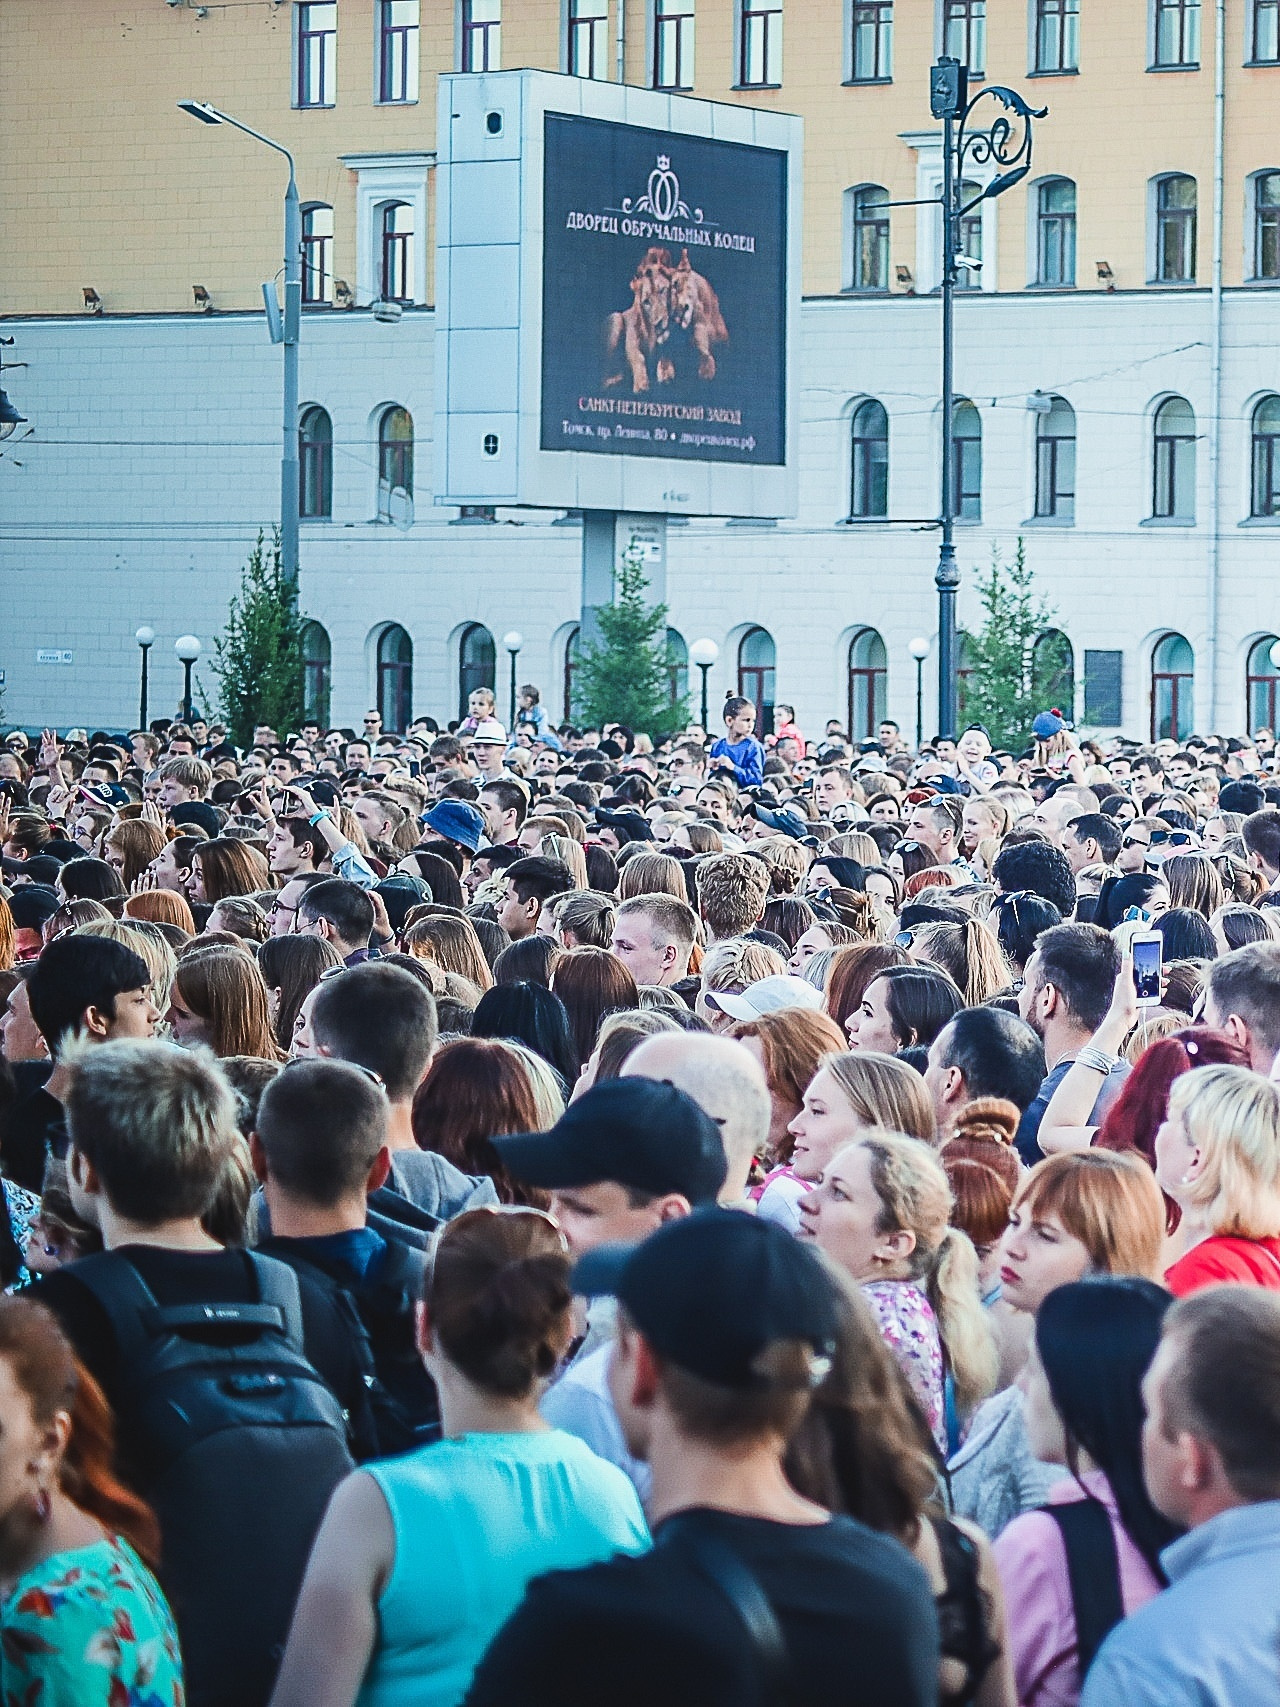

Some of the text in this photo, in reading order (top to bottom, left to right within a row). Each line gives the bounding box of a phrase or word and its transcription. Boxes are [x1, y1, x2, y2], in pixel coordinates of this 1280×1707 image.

[566, 211, 756, 253] ДВОРЕЦ ОБРУЧАЛЬНЫХ КОЛЕЦ
